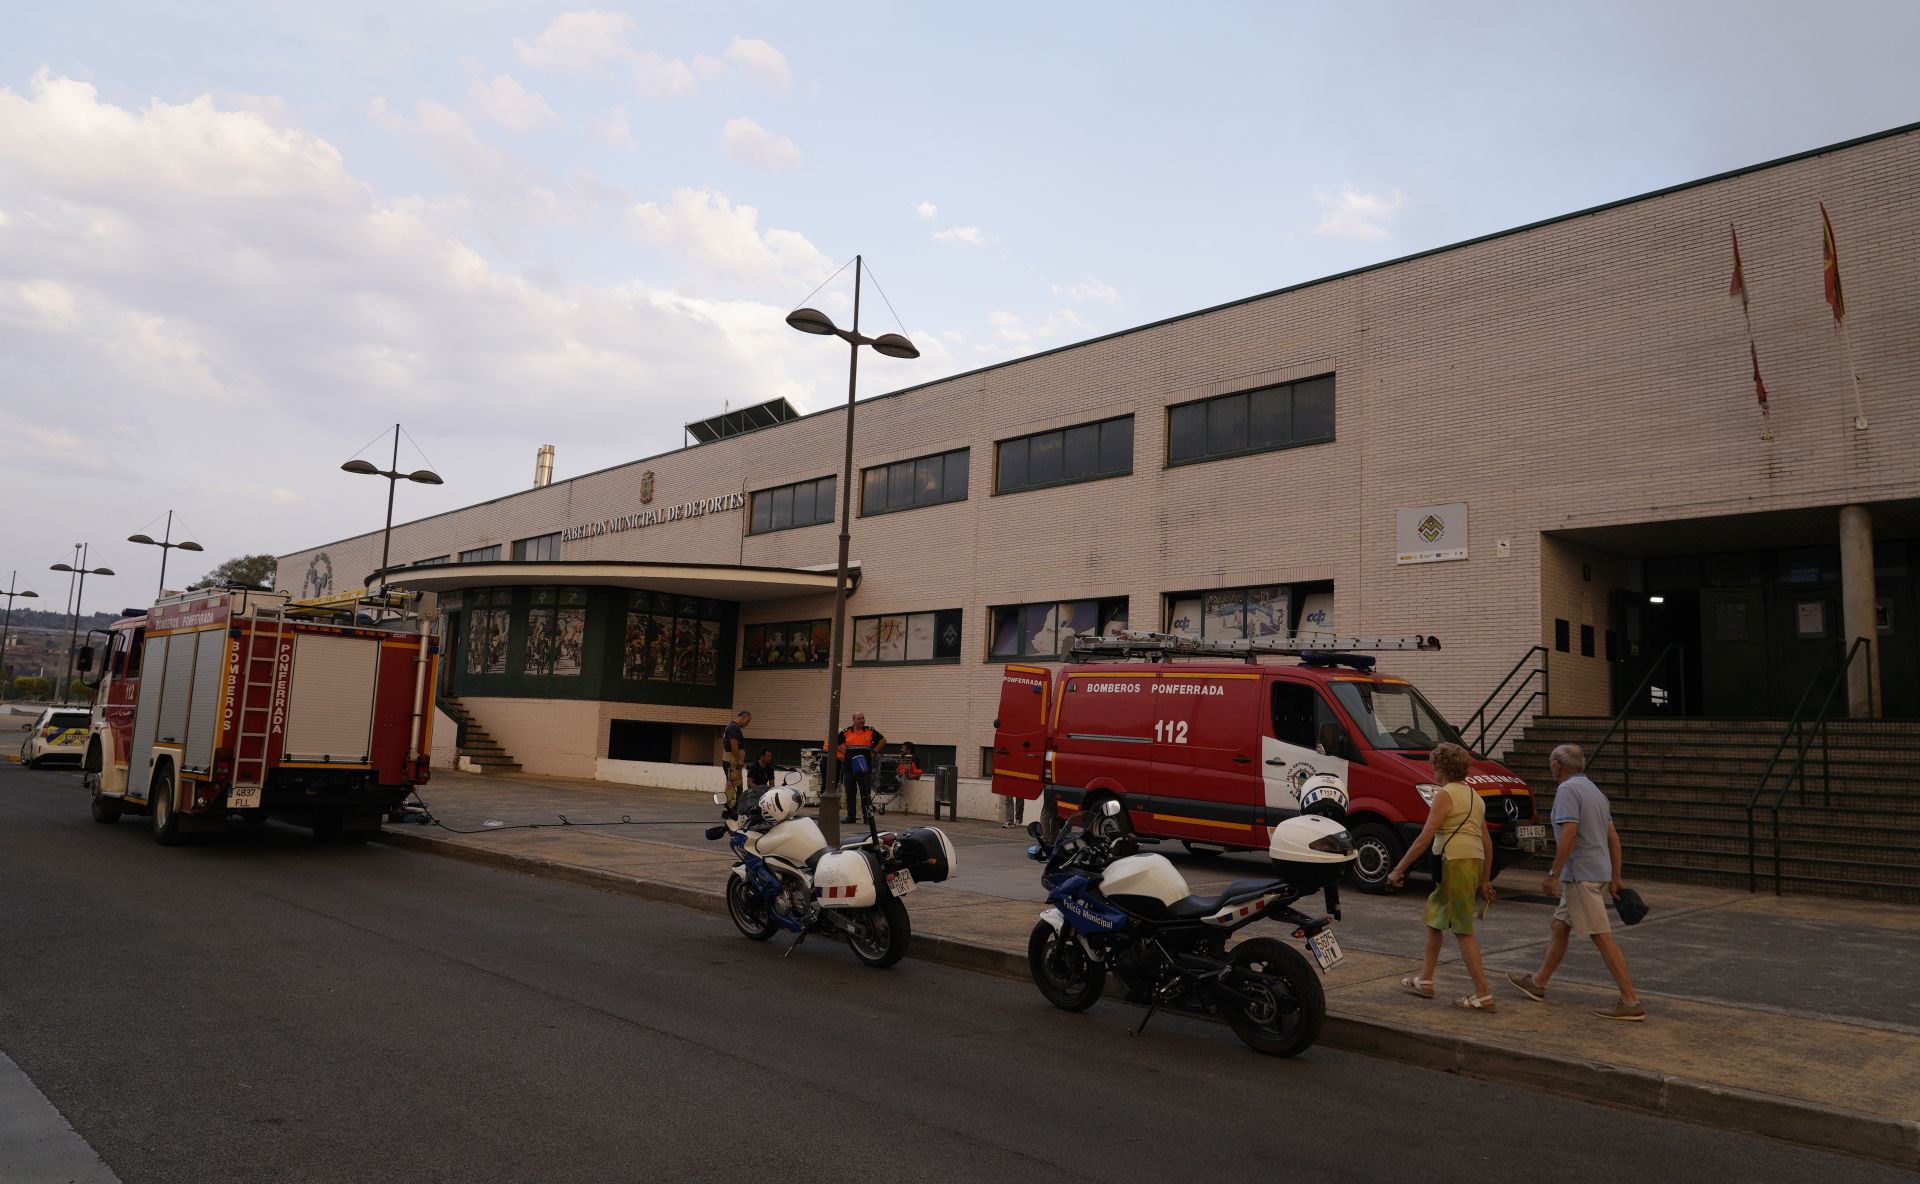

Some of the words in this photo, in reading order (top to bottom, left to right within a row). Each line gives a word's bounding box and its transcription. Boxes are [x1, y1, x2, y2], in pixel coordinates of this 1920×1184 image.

[561, 520, 608, 541] PABELLON
[610, 509, 665, 533] MUNICIPAL
[668, 504, 683, 521] DE
[685, 493, 744, 518] DEPORTES
[155, 617, 179, 631] BOMBEROS
[182, 611, 214, 627] PONFERRADA
[223, 641, 240, 731] BOMBEROS
[271, 644, 291, 734] PONFERRADA
[1003, 676, 1043, 686] PONFERRADA
[1087, 683, 1141, 693] BOMBEROS
[1151, 684, 1224, 696] PONFERRADA
[125, 683, 135, 700] 112
[1154, 719, 1189, 744] 112
[235, 788, 257, 798] 4837
[235, 798, 250, 807] FLL
[1082, 910, 1113, 930] Municipal
